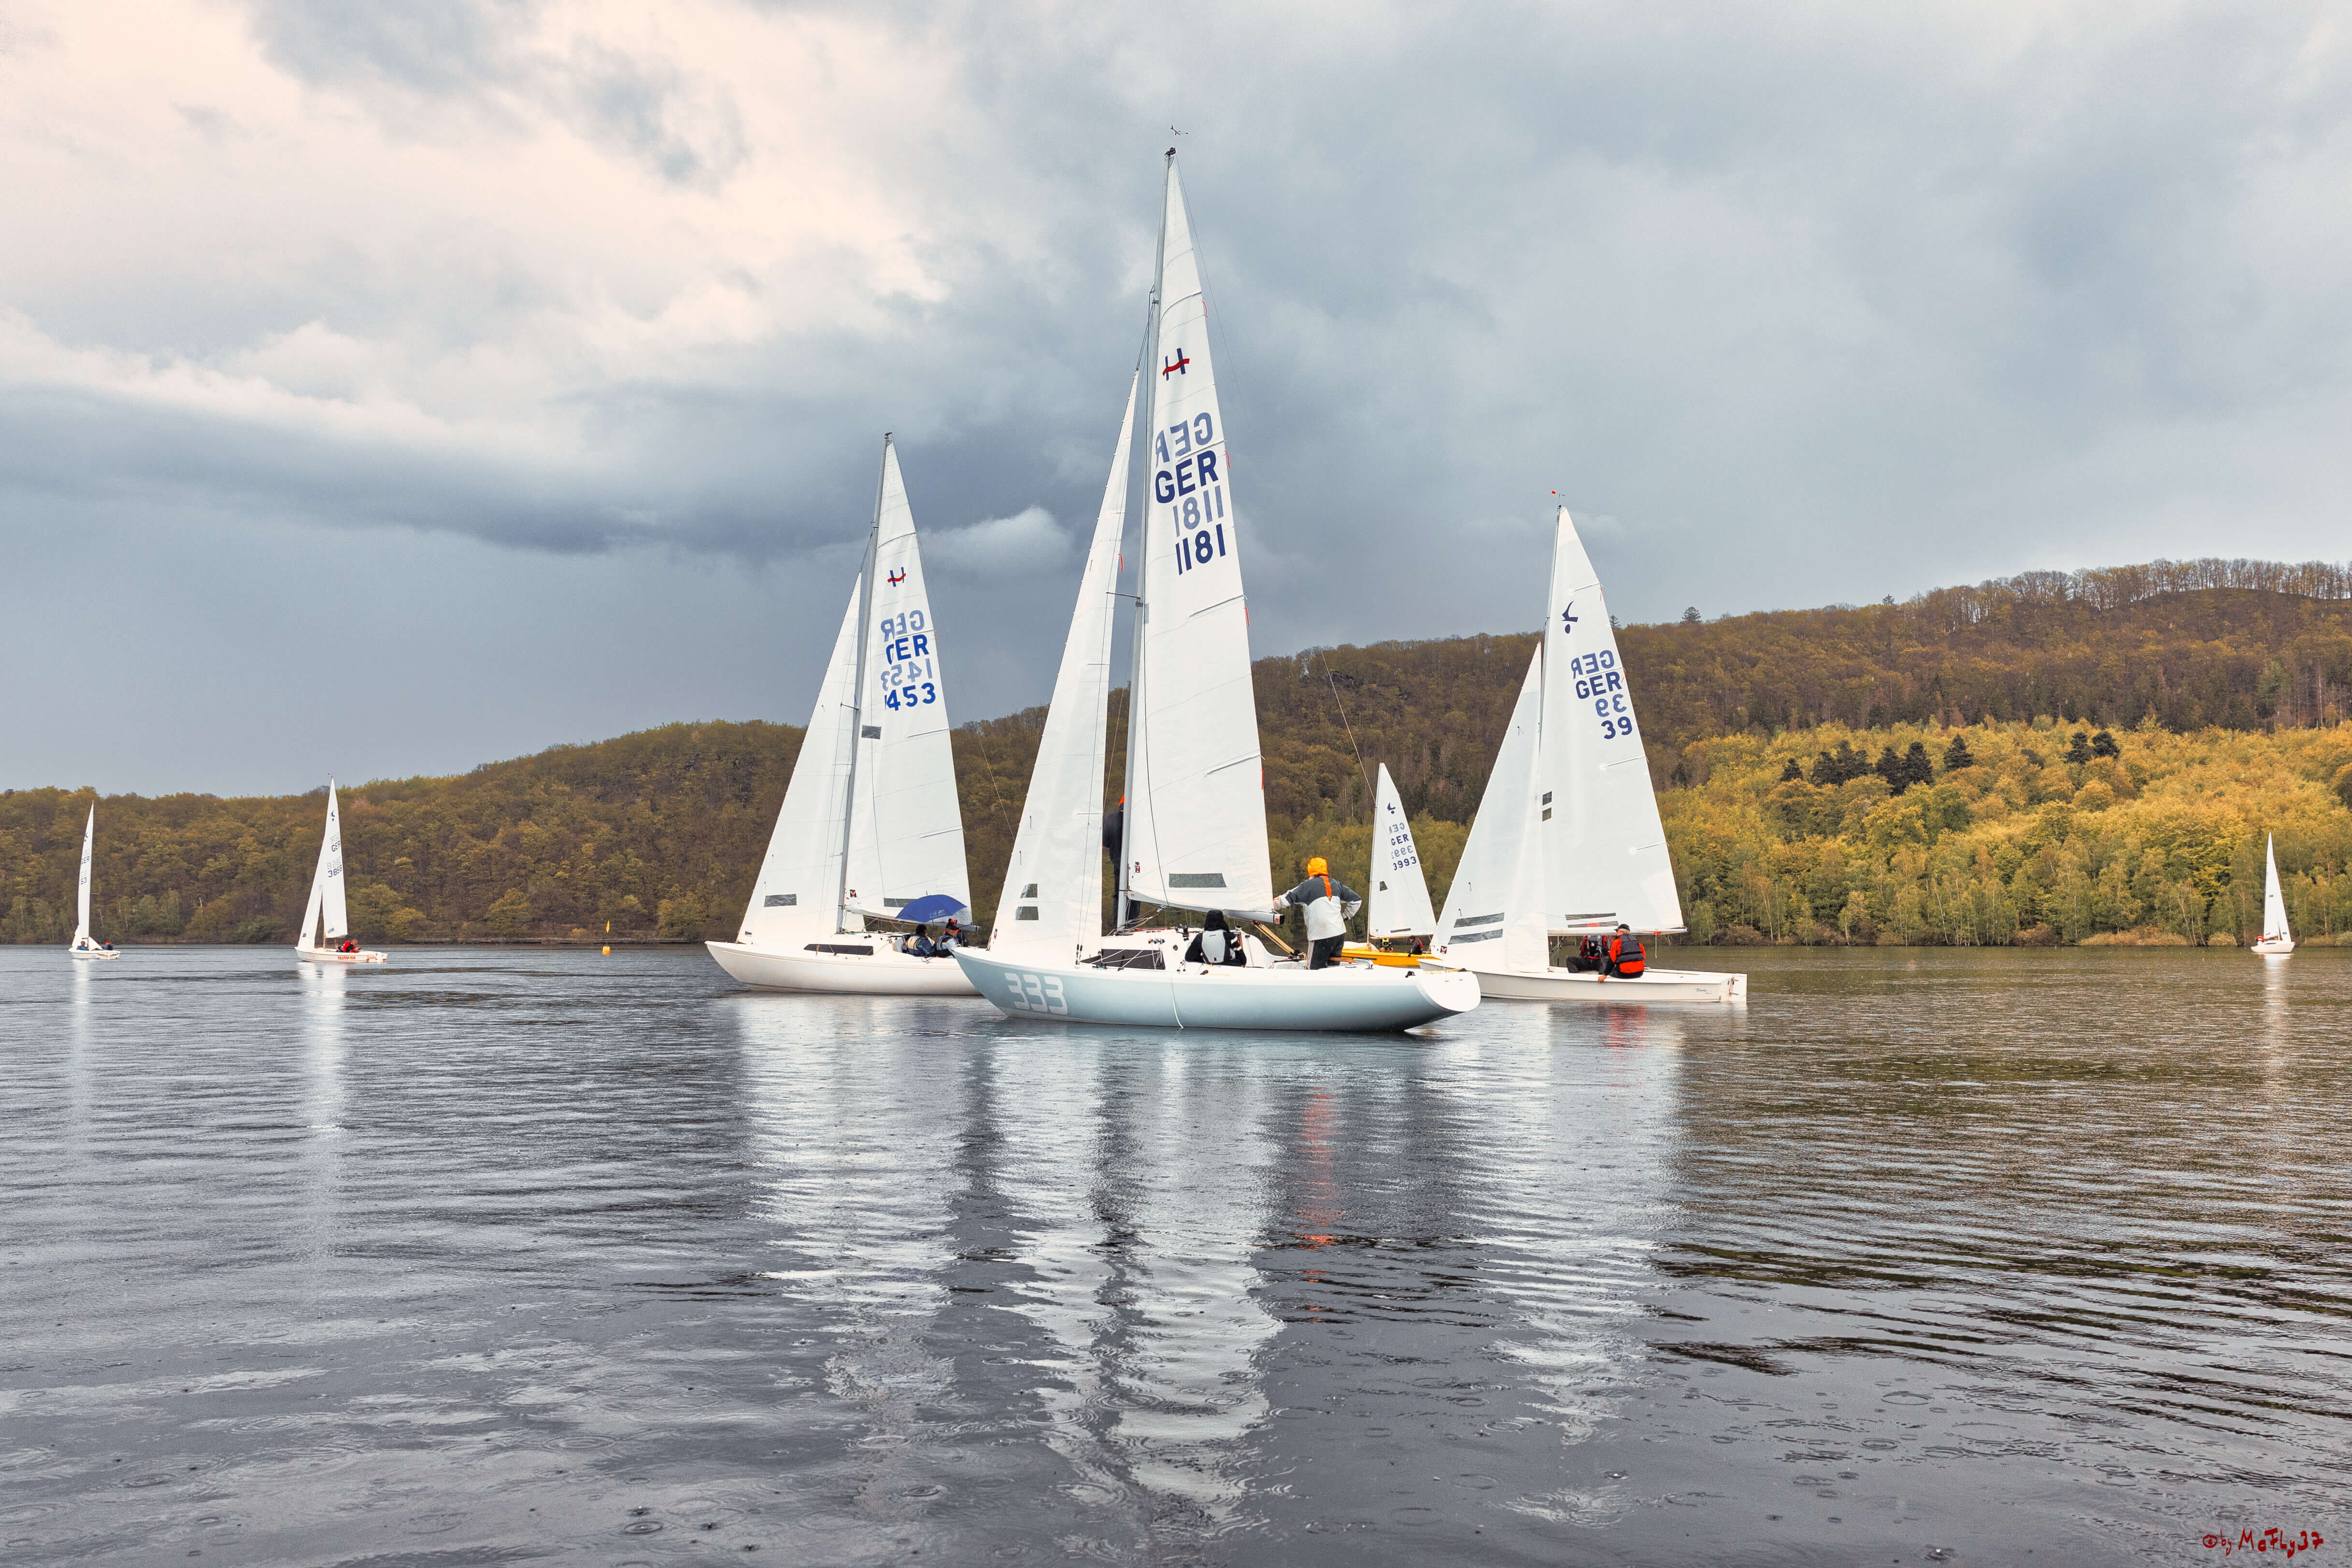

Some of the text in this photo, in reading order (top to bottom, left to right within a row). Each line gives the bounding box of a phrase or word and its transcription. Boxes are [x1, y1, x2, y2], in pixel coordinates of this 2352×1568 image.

[1155, 450, 1219, 503] GER
[1175, 523, 1226, 576] 1181
[1576, 671, 1623, 699] GER
[1600, 716, 1633, 740] 39
[331, 840, 341, 852] GER
[1391, 834, 1409, 846] GER
[1393, 856, 1417, 871] 3993
[1004, 972, 1068, 1015] 333
